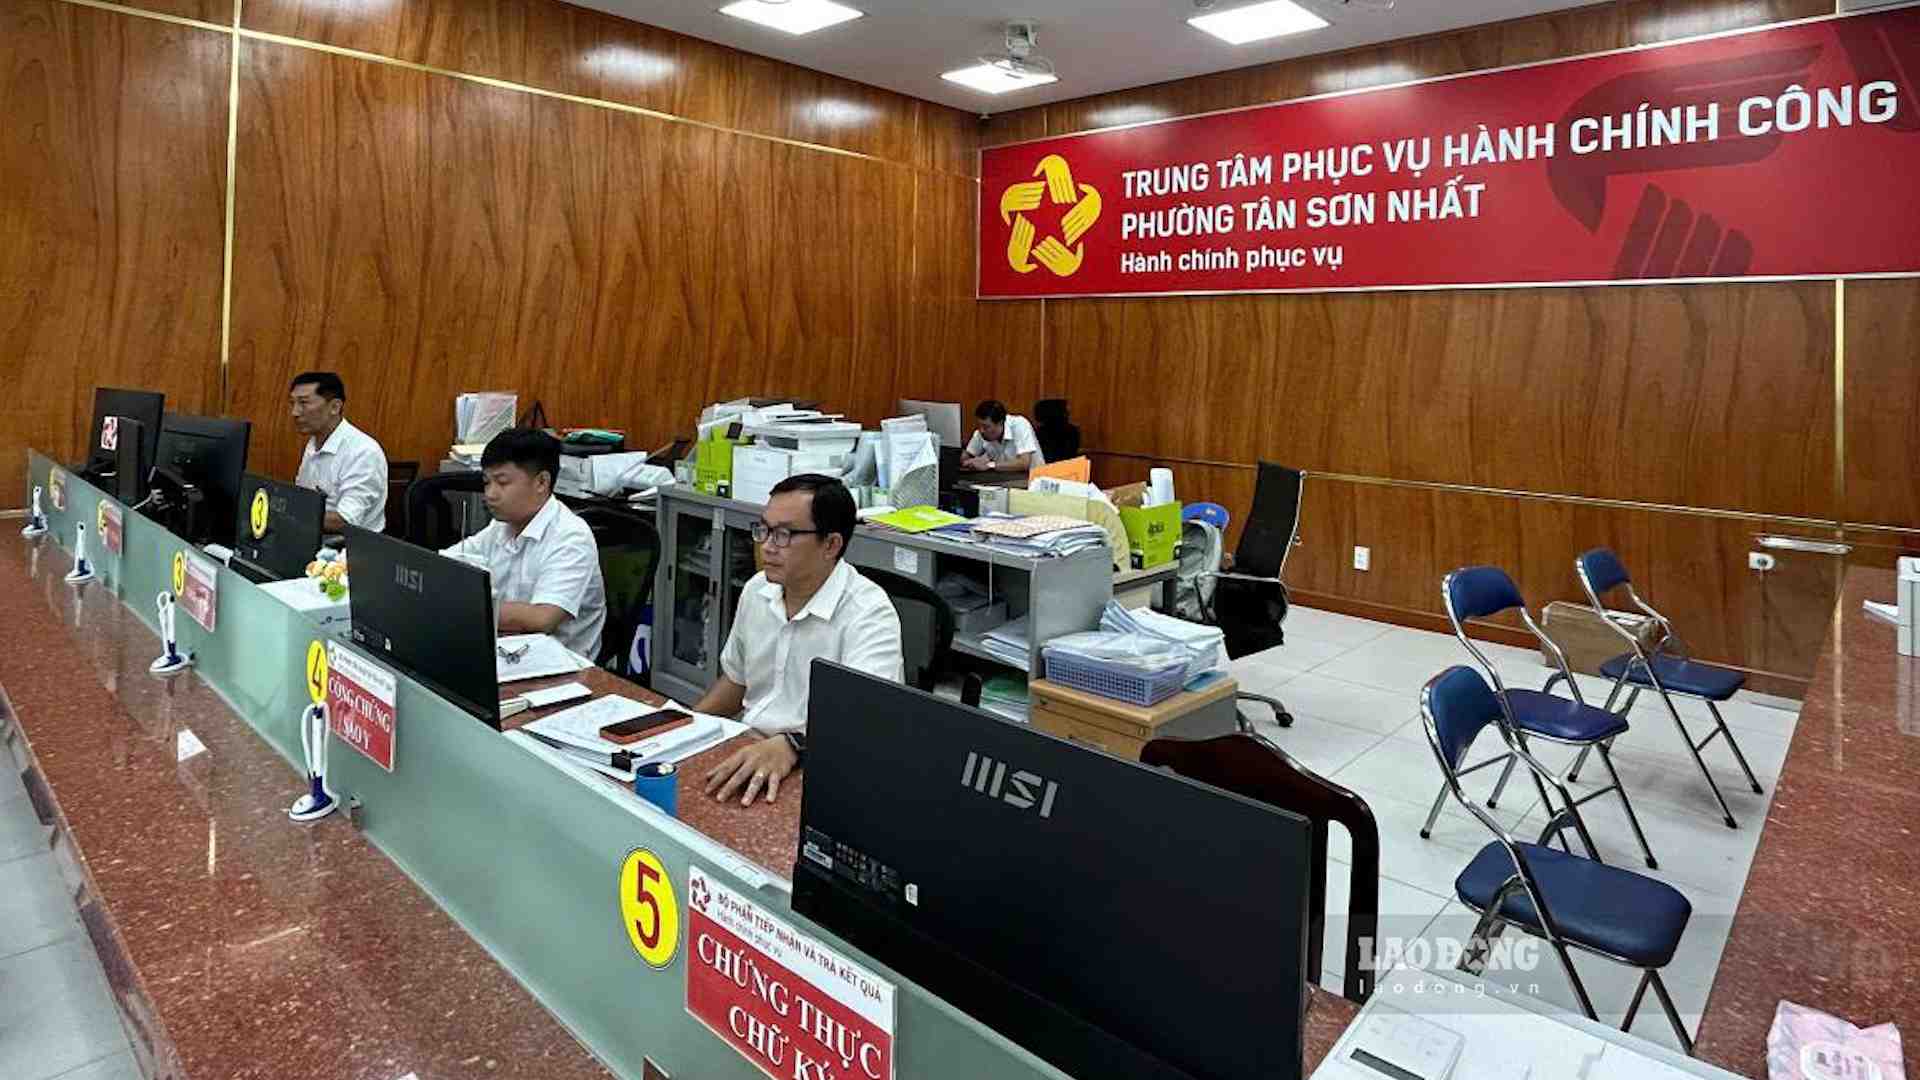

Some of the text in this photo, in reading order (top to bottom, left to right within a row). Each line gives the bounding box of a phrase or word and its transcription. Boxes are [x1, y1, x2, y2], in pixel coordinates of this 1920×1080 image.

[1123, 80, 1898, 198] TRUNG TÂM PHỤC VỤ HÀNH CHÍNH CÔNG
[1122, 174, 1485, 240] PHƯỜNG TÂN SƠN NHẤT
[1121, 245, 1343, 273] Hành chính phục vụ
[256, 496, 264, 529] 3
[176, 556, 182, 591] 3
[394, 563, 424, 593] MSI
[313, 648, 323, 697] 4
[960, 752, 1060, 818] MSI
[635, 860, 660, 950] 5
[698, 933, 881, 1079] CHỨNG THỰC
[729, 1005, 789, 1066] CHỮ
